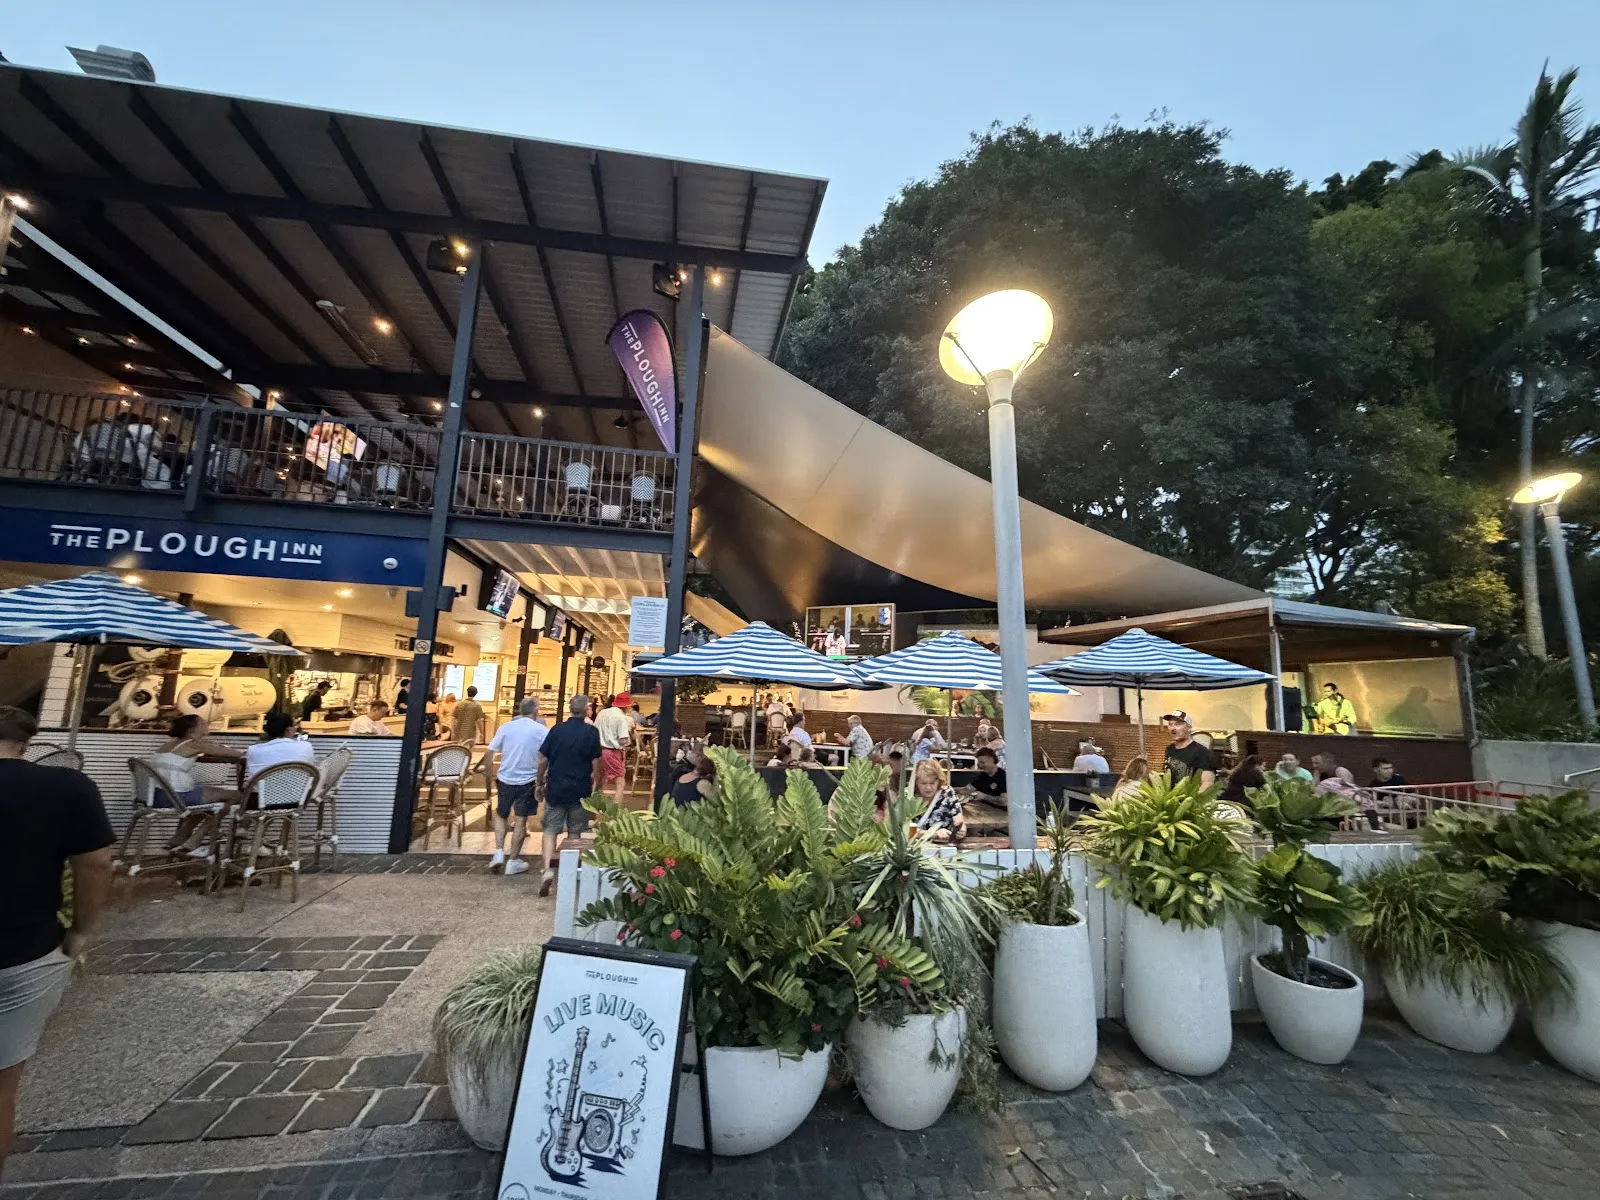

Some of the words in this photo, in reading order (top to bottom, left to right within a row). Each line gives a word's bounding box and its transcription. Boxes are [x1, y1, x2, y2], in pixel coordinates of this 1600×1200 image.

[620, 325, 635, 345] THE
[630, 340, 664, 407] PLOUGH
[657, 402, 670, 423] INN
[50, 532, 100, 549] THE
[106, 528, 276, 561] PLOUGH
[282, 542, 323, 557] INN
[596, 972, 628, 983] PLOUGH
[544, 994, 592, 1033] LIVE
[596, 993, 665, 1051] MUSIC
